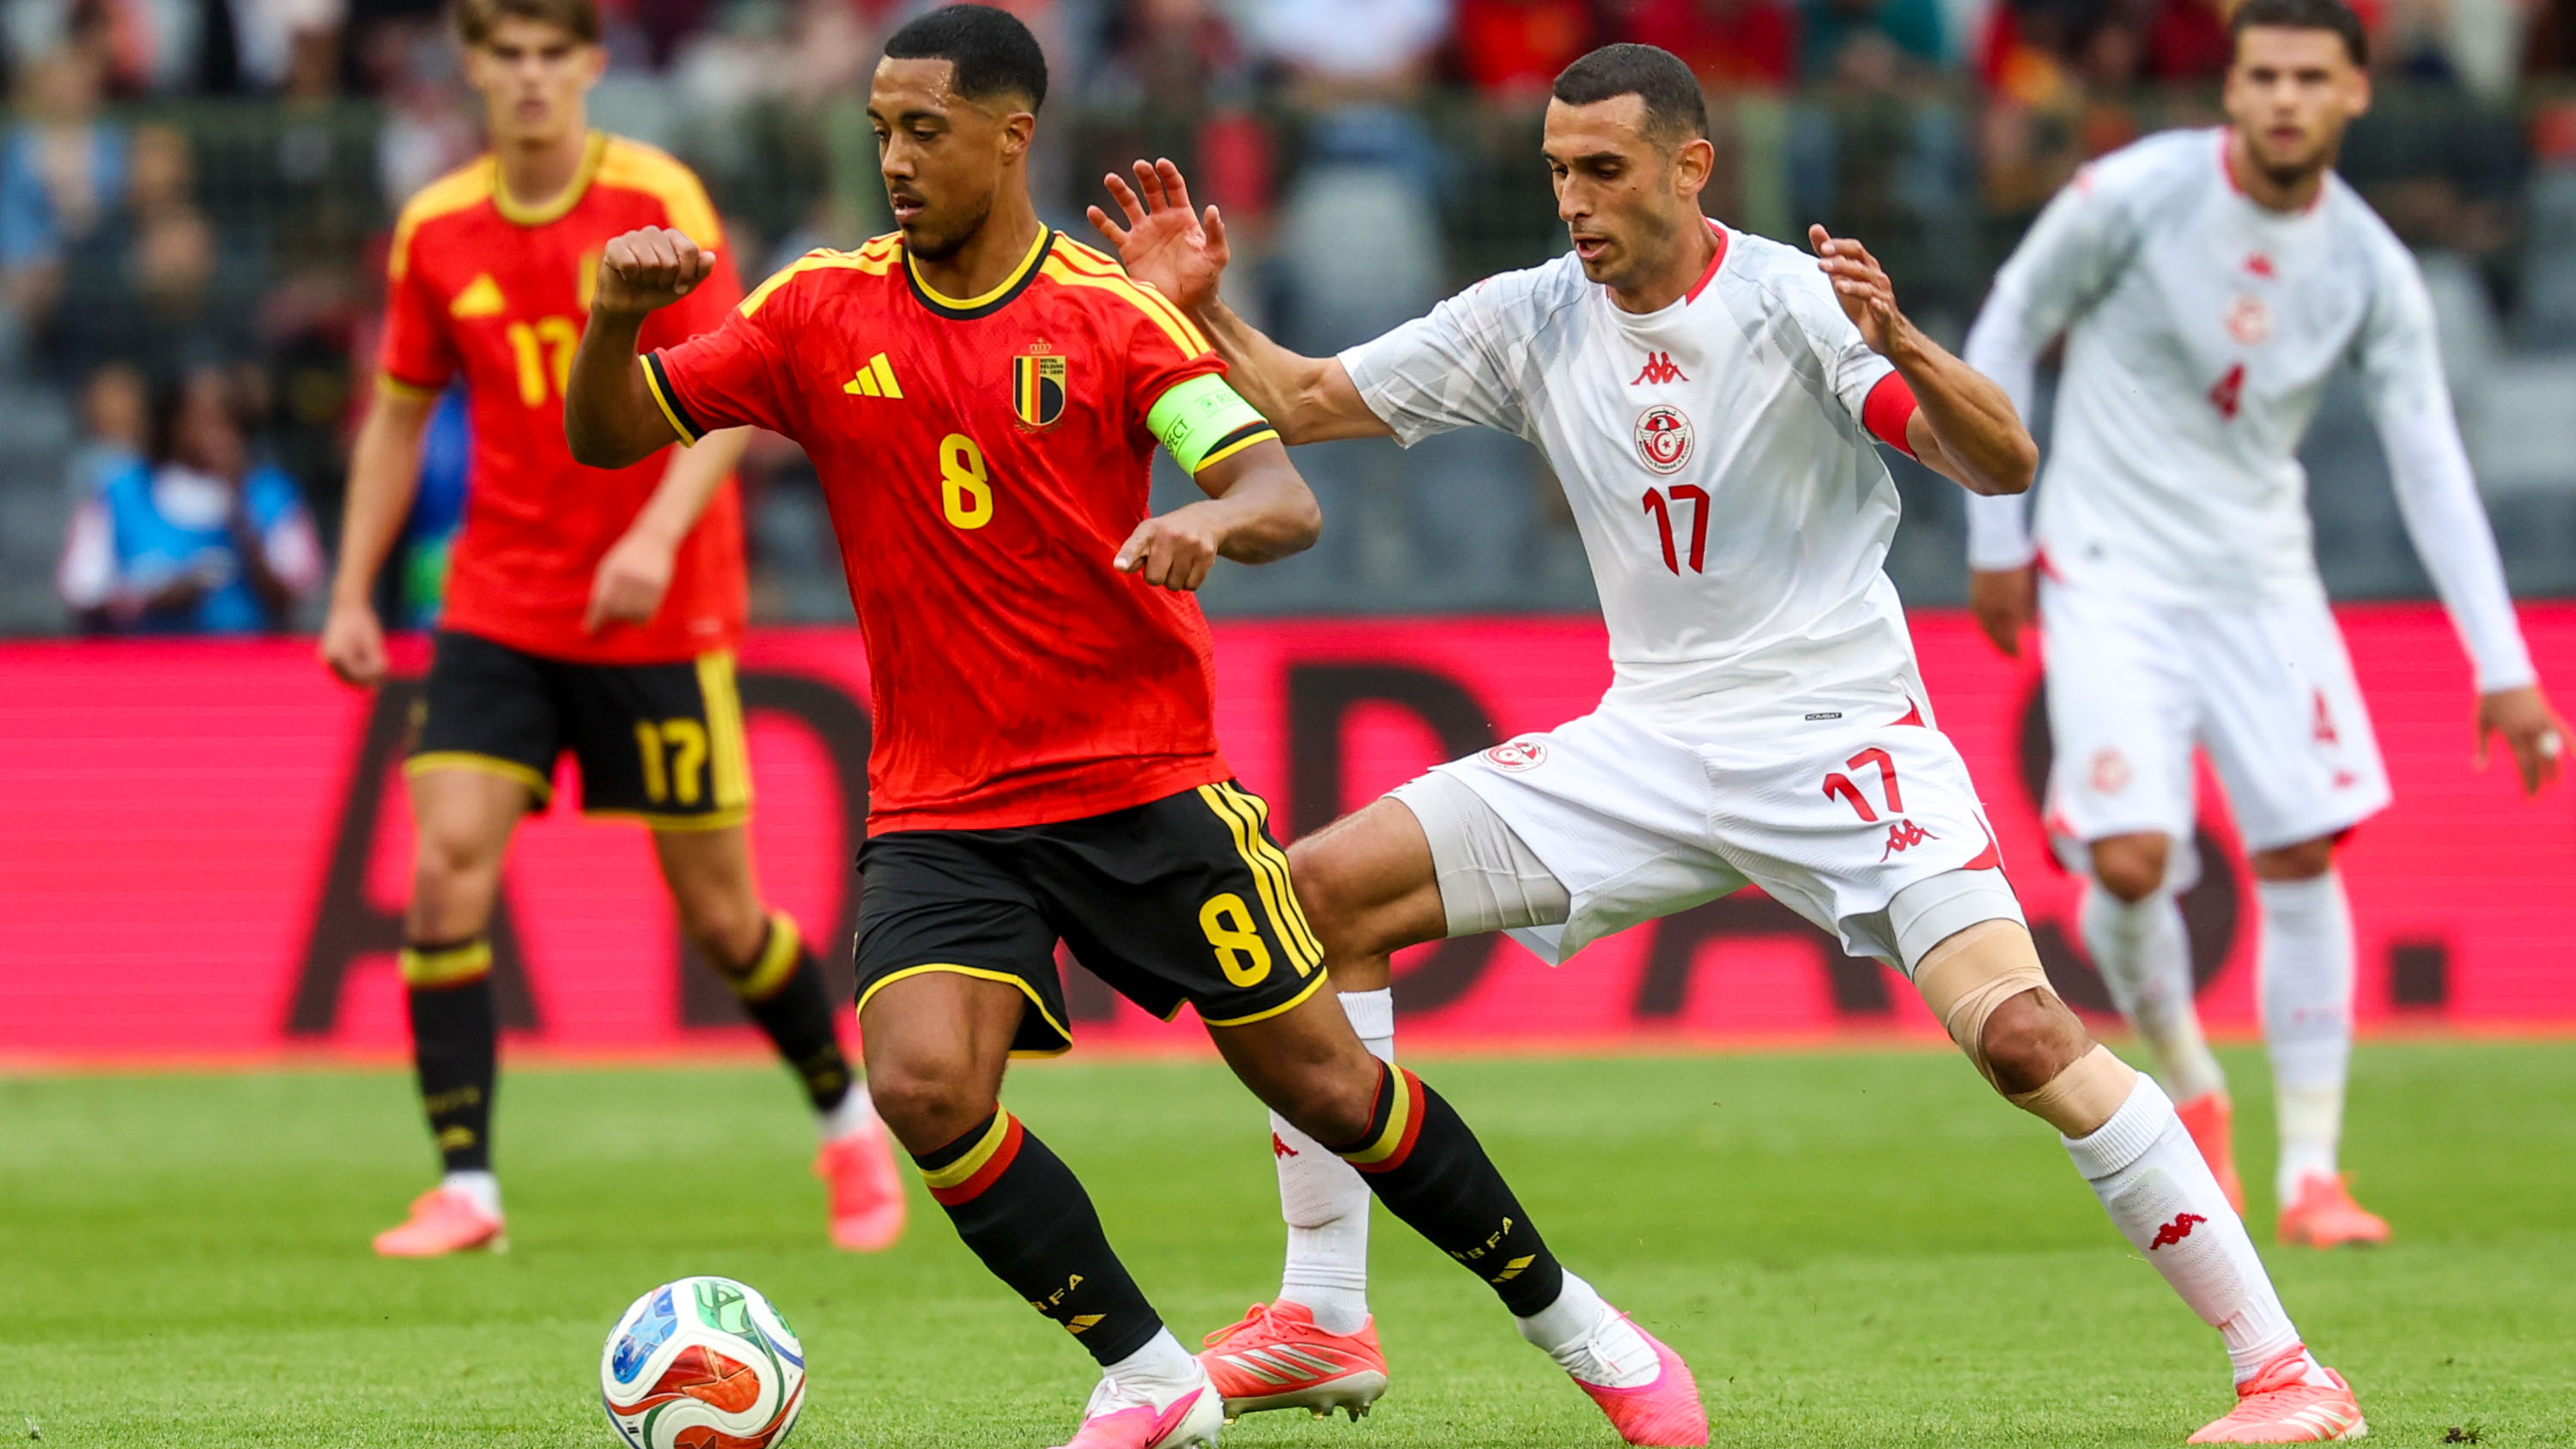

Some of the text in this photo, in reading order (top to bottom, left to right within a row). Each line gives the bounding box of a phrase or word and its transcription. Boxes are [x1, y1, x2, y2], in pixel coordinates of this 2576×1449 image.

[507, 317, 578, 406] 17
[2208, 361, 2245, 422] 4
[939, 433, 993, 530] 8
[1642, 484, 1710, 577] 17
[635, 718, 706, 804] 17
[1822, 747, 1905, 822] 17
[1199, 892, 1273, 989] 8
